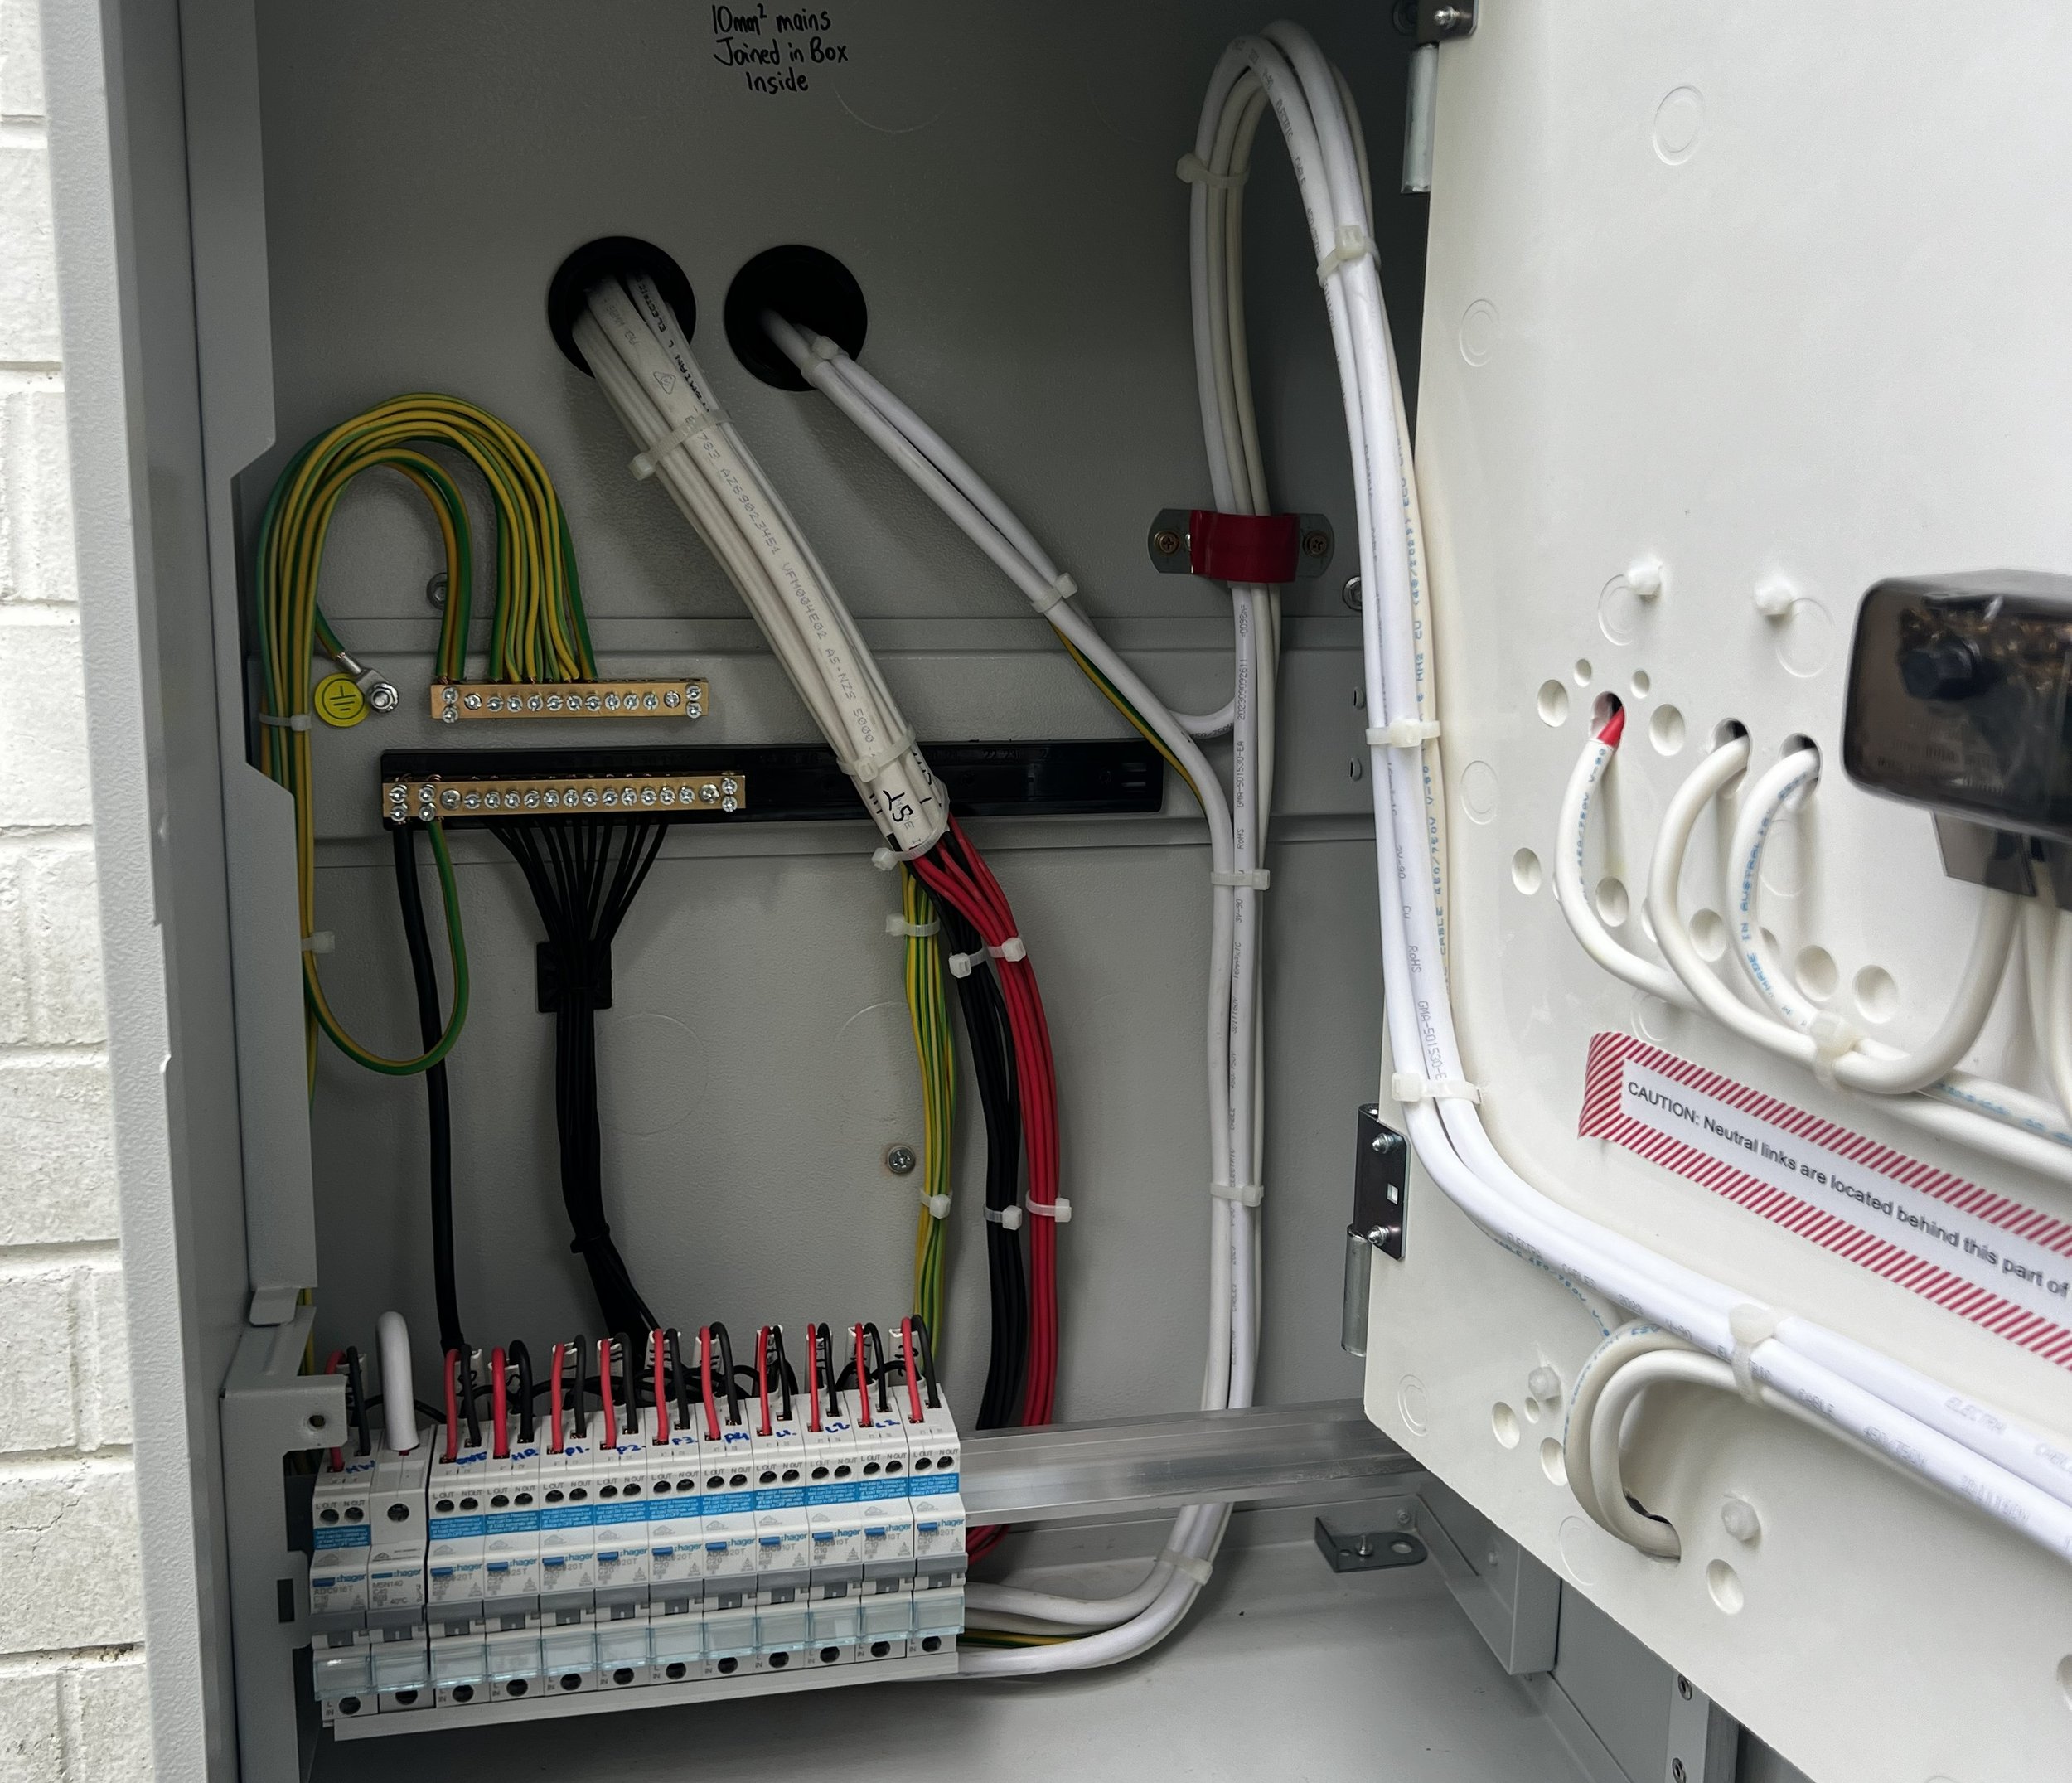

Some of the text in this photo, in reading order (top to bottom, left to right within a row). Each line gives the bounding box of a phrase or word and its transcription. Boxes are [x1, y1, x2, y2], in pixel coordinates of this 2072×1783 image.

[776, 9, 831, 33] mains
[714, 36, 848, 66] Joined in Box
[746, 67, 809, 94] Inside
[1235, 828, 1245, 850] RoHS
[1739, 922, 1751, 942] IN
[1407, 944, 1423, 973] RoHS
[1627, 1080, 2070, 1298] CAUTION: Neutral links are located behind this part of
